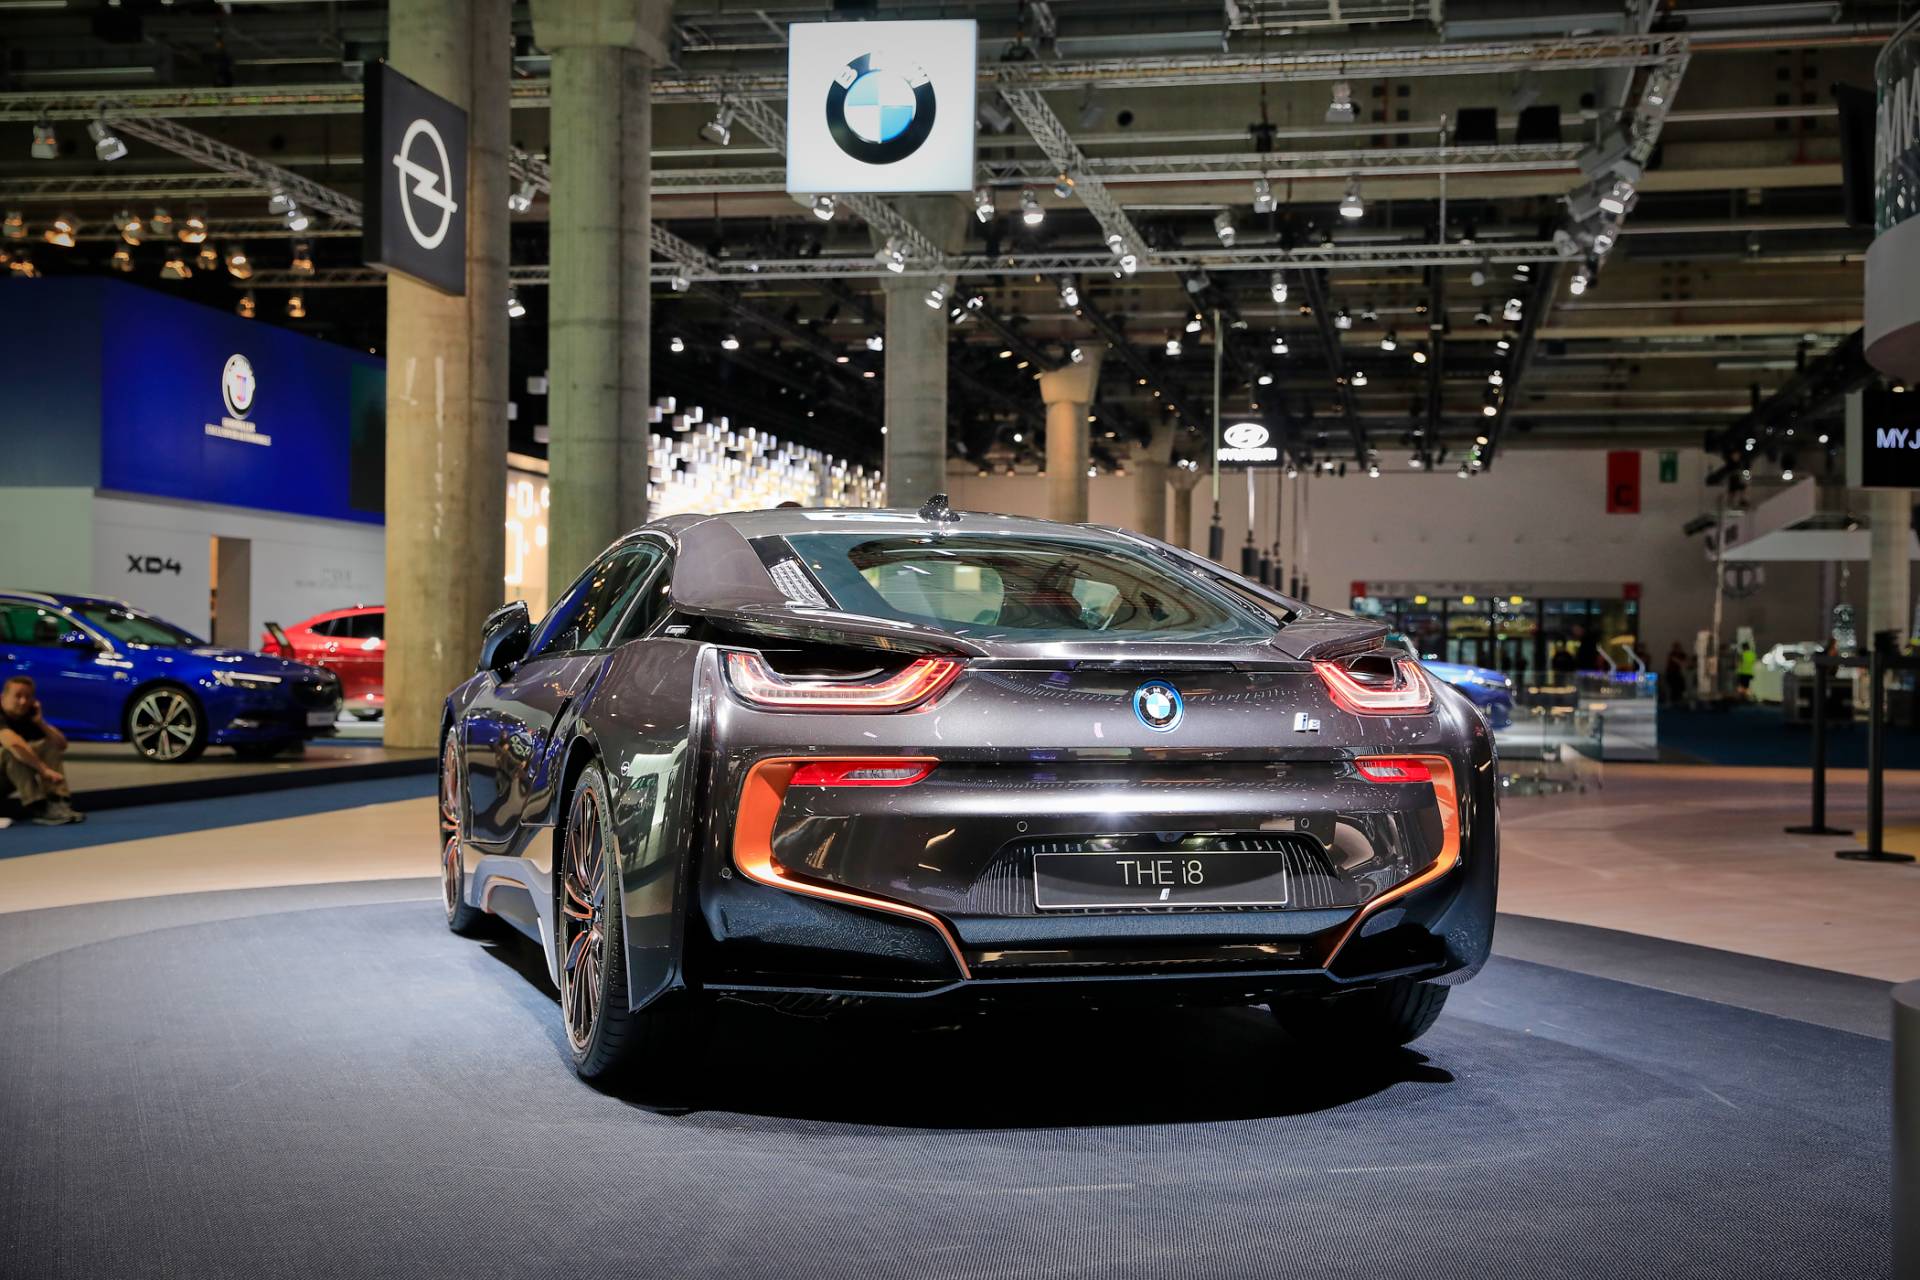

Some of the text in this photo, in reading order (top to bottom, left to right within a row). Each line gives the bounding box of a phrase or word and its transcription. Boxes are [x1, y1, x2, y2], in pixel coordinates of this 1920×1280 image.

[127, 554, 182, 576] XD4
[1116, 860, 1204, 885] THE i8
